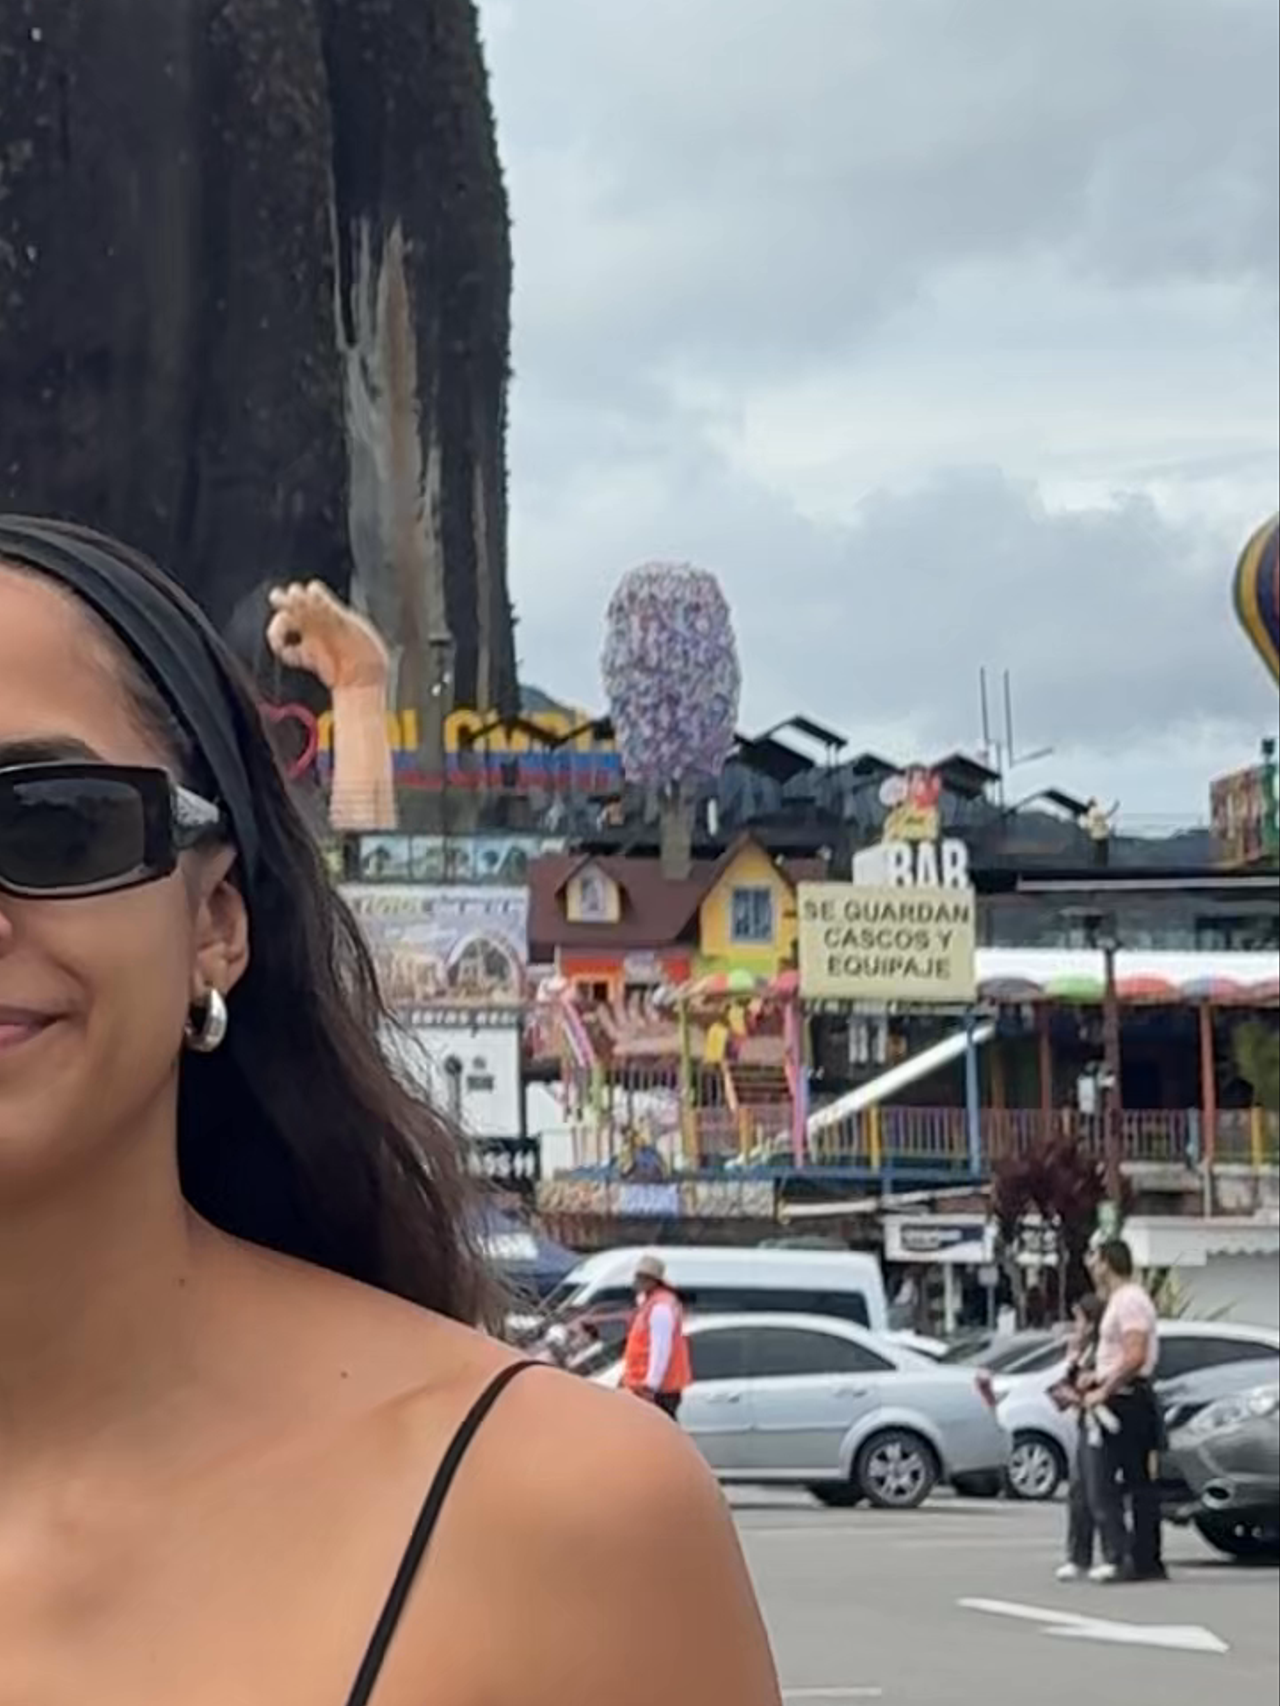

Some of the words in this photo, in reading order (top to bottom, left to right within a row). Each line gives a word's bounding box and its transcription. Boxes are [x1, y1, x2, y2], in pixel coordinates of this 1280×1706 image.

[888, 839, 970, 888] BAR
[803, 899, 835, 921] SE
[843, 900, 969, 924] GUARDAN
[823, 928, 930, 951] CASCOS
[939, 929, 954, 951] Y
[827, 955, 952, 979] EQUIPAJE
